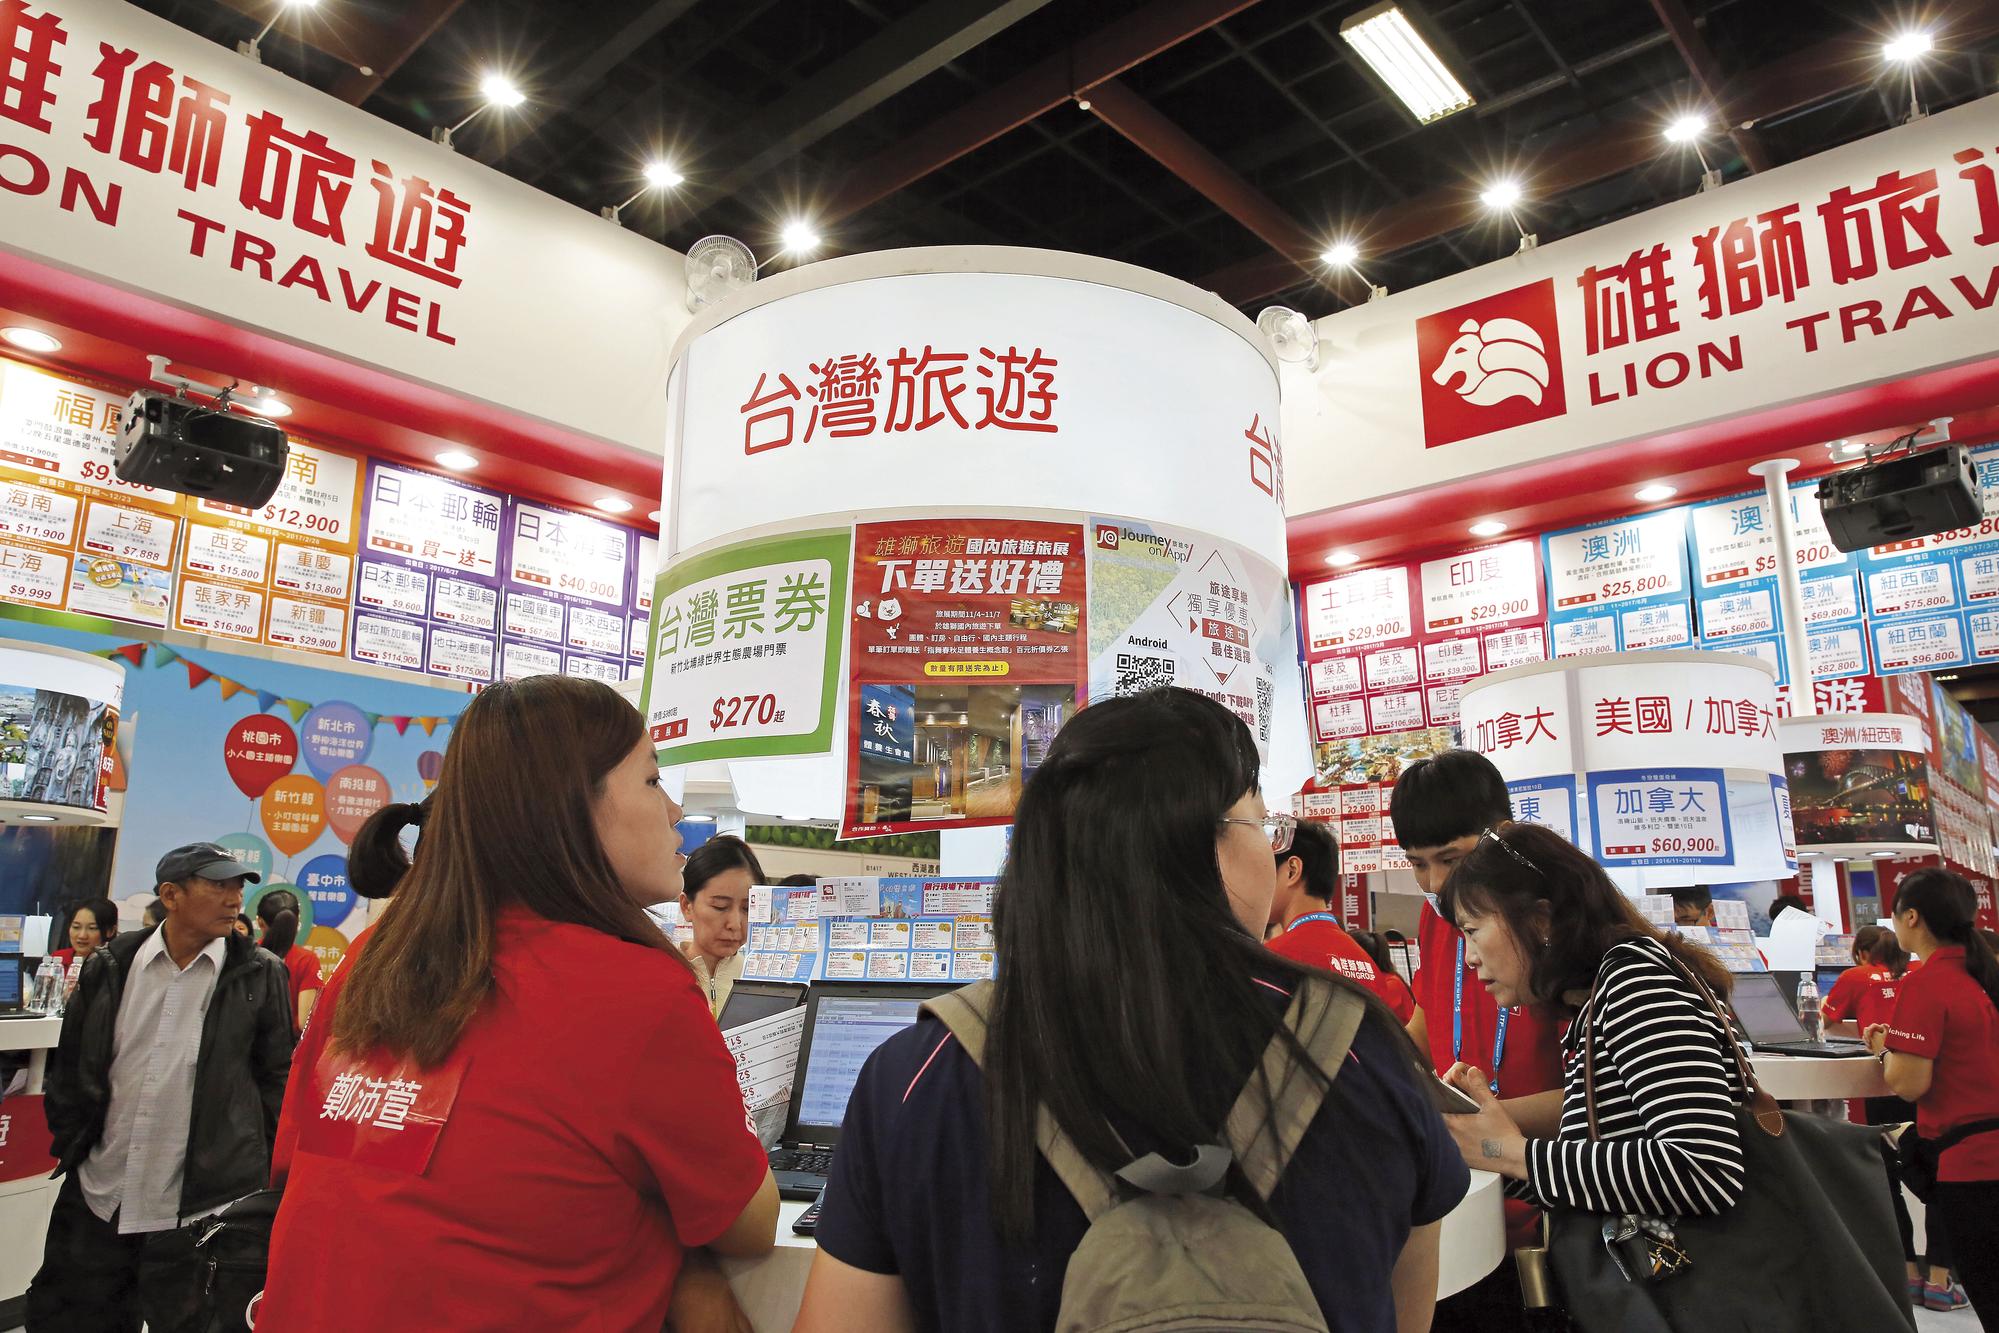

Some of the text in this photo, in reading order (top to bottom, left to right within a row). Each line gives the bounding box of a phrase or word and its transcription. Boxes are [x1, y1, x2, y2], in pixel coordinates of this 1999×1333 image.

[176, 208, 458, 346] TRAVEL
[1588, 334, 1743, 407] LION
[740, 344, 1059, 456] 台灣旅遊
[6, 488, 53, 513] 海南
[375, 474, 499, 531] 日本郵輪
[112, 512, 154, 534] 上海
[264, 503, 340, 534] $12,900
[16, 523, 65, 541] $11,900
[1121, 528, 1169, 547] Journey
[123, 545, 160, 561] $7,888
[211, 534, 248, 553] 西安
[421, 540, 492, 567] 買一送一
[1581, 527, 1641, 563] 澳洲
[0, 550, 42, 573] 上海
[297, 551, 332, 571] 重慶
[1975, 558, 1999, 576] 紐
[219, 564, 260, 580] $15,800
[365, 566, 425, 592] 日本郵輪
[877, 559, 1064, 594] 下單送好禮
[1450, 557, 1503, 587] 印度
[1881, 569, 1938, 590] 紐西蘭
[9, 585, 52, 600] $9,999
[195, 586, 251, 611] 張家界
[304, 581, 342, 596] $13,800
[438, 581, 494, 606] 日本郵輪
[1320, 576, 1394, 611] 土耳其
[290, 604, 326, 625] 新疆
[1187, 593, 1248, 626] 獨享優惠
[1471, 598, 1529, 621] $29,900
[1720, 596, 1752, 614] 澳洲
[572, 611, 621, 633] 馬來西亞
[658, 572, 826, 659] 台灣票券
[1640, 610, 1670, 626] 澳洲
[1973, 616, 1999, 633] 紐
[212, 620, 253, 635] $16,900
[1208, 621, 1244, 643] 旅途中
[1570, 621, 1598, 637] 澳洲
[1888, 623, 1947, 645] 紐西蘭
[299, 635, 337, 649] $29,900
[1128, 635, 1168, 650] Android
[1438, 643, 1464, 658] 印度
[1486, 631, 1541, 650] 斯里蘭卡
[670, 642, 787, 676] 新竹北埔綠世界生態農場門票
[1211, 641, 1251, 664] 最佳選擇
[1329, 703, 1352, 718] 杜拜
[1384, 696, 1407, 710] 杜拜
[318, 718, 356, 733] 新北市
[1595, 696, 1672, 736] 美國
[1704, 697, 1777, 742] 加拿大
[242, 730, 281, 745] 桃園市
[1476, 706, 1557, 755] 加拿大
[227, 749, 293, 765] 小人國主題樂園
[339, 776, 377, 792] 南投縣
[274, 790, 314, 806] 新竹縣
[1614, 786, 1706, 814] 加拿大
[336, 806, 376, 817] 九族文化
[1308, 807, 1336, 817] 35,900
[1347, 804, 1376, 814] 22,900
[1349, 834, 1377, 843] 10,900
[1354, 864, 1377, 872] 8,999
[307, 873, 346, 887] 臺中市
[320, 1072, 422, 1131] 鄭沛萱
